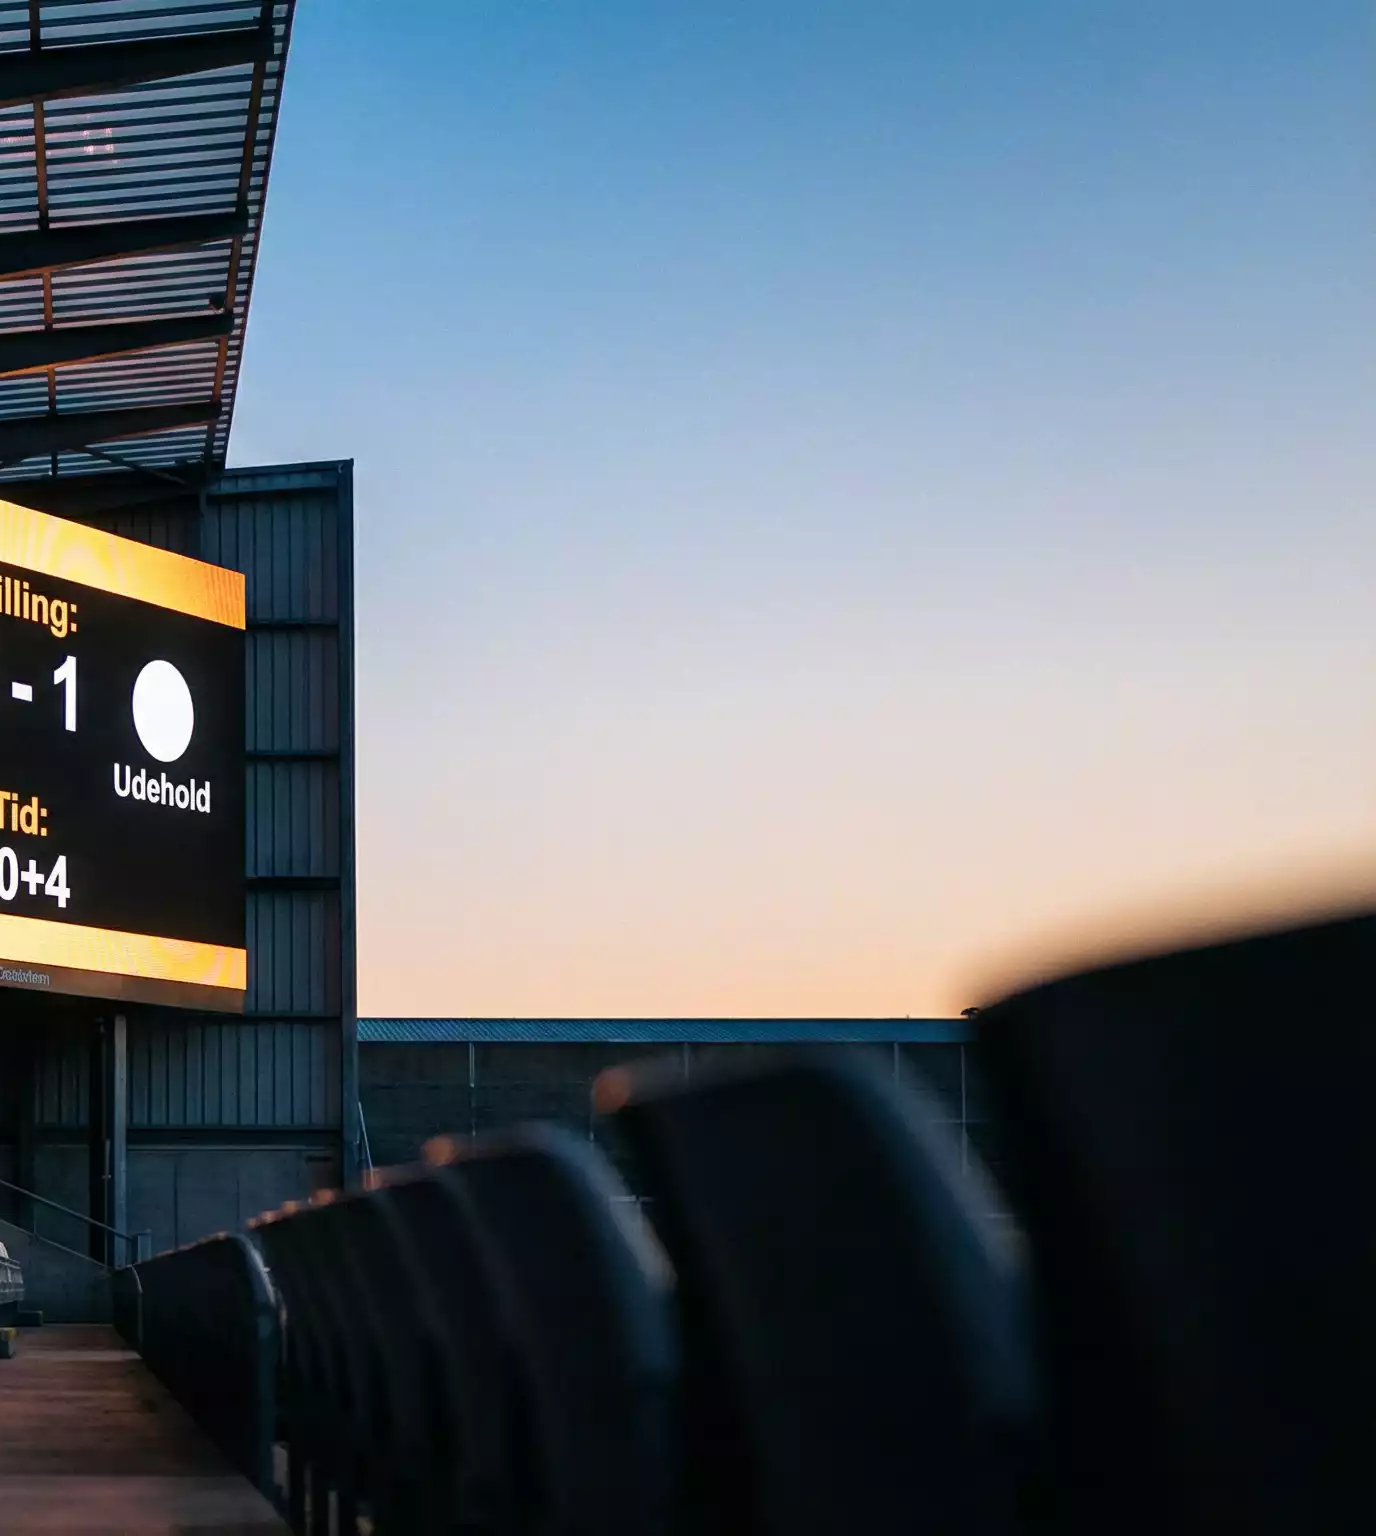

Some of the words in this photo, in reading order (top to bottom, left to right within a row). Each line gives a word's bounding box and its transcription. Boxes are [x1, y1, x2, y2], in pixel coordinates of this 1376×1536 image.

[12, 681, 33, 702] -
[53, 655, 77, 732] 1
[113, 763, 211, 813] Udehold
